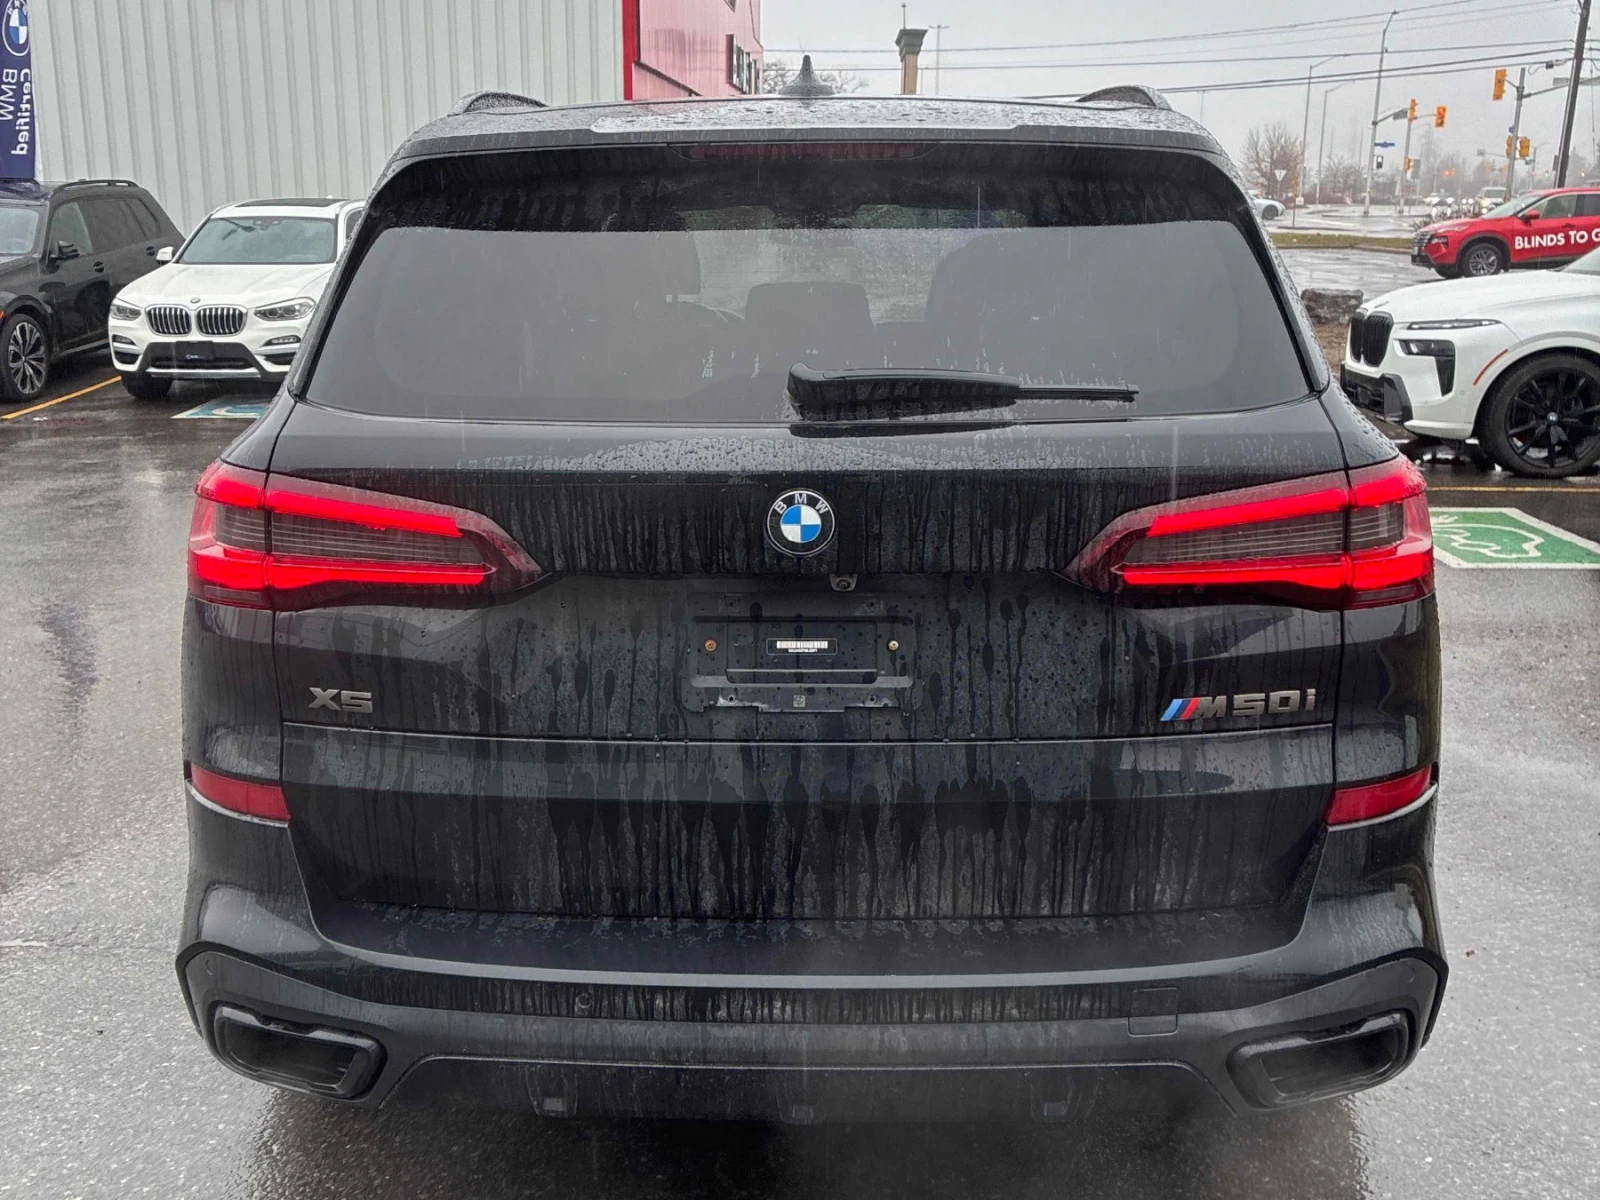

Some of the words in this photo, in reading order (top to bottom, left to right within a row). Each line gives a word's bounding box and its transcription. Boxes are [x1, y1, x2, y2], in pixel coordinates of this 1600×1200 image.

[1515, 233, 1565, 249] BLINDS
[1569, 230, 1588, 244] TO
[774, 493, 829, 515] BMW
[308, 687, 372, 713] X5
